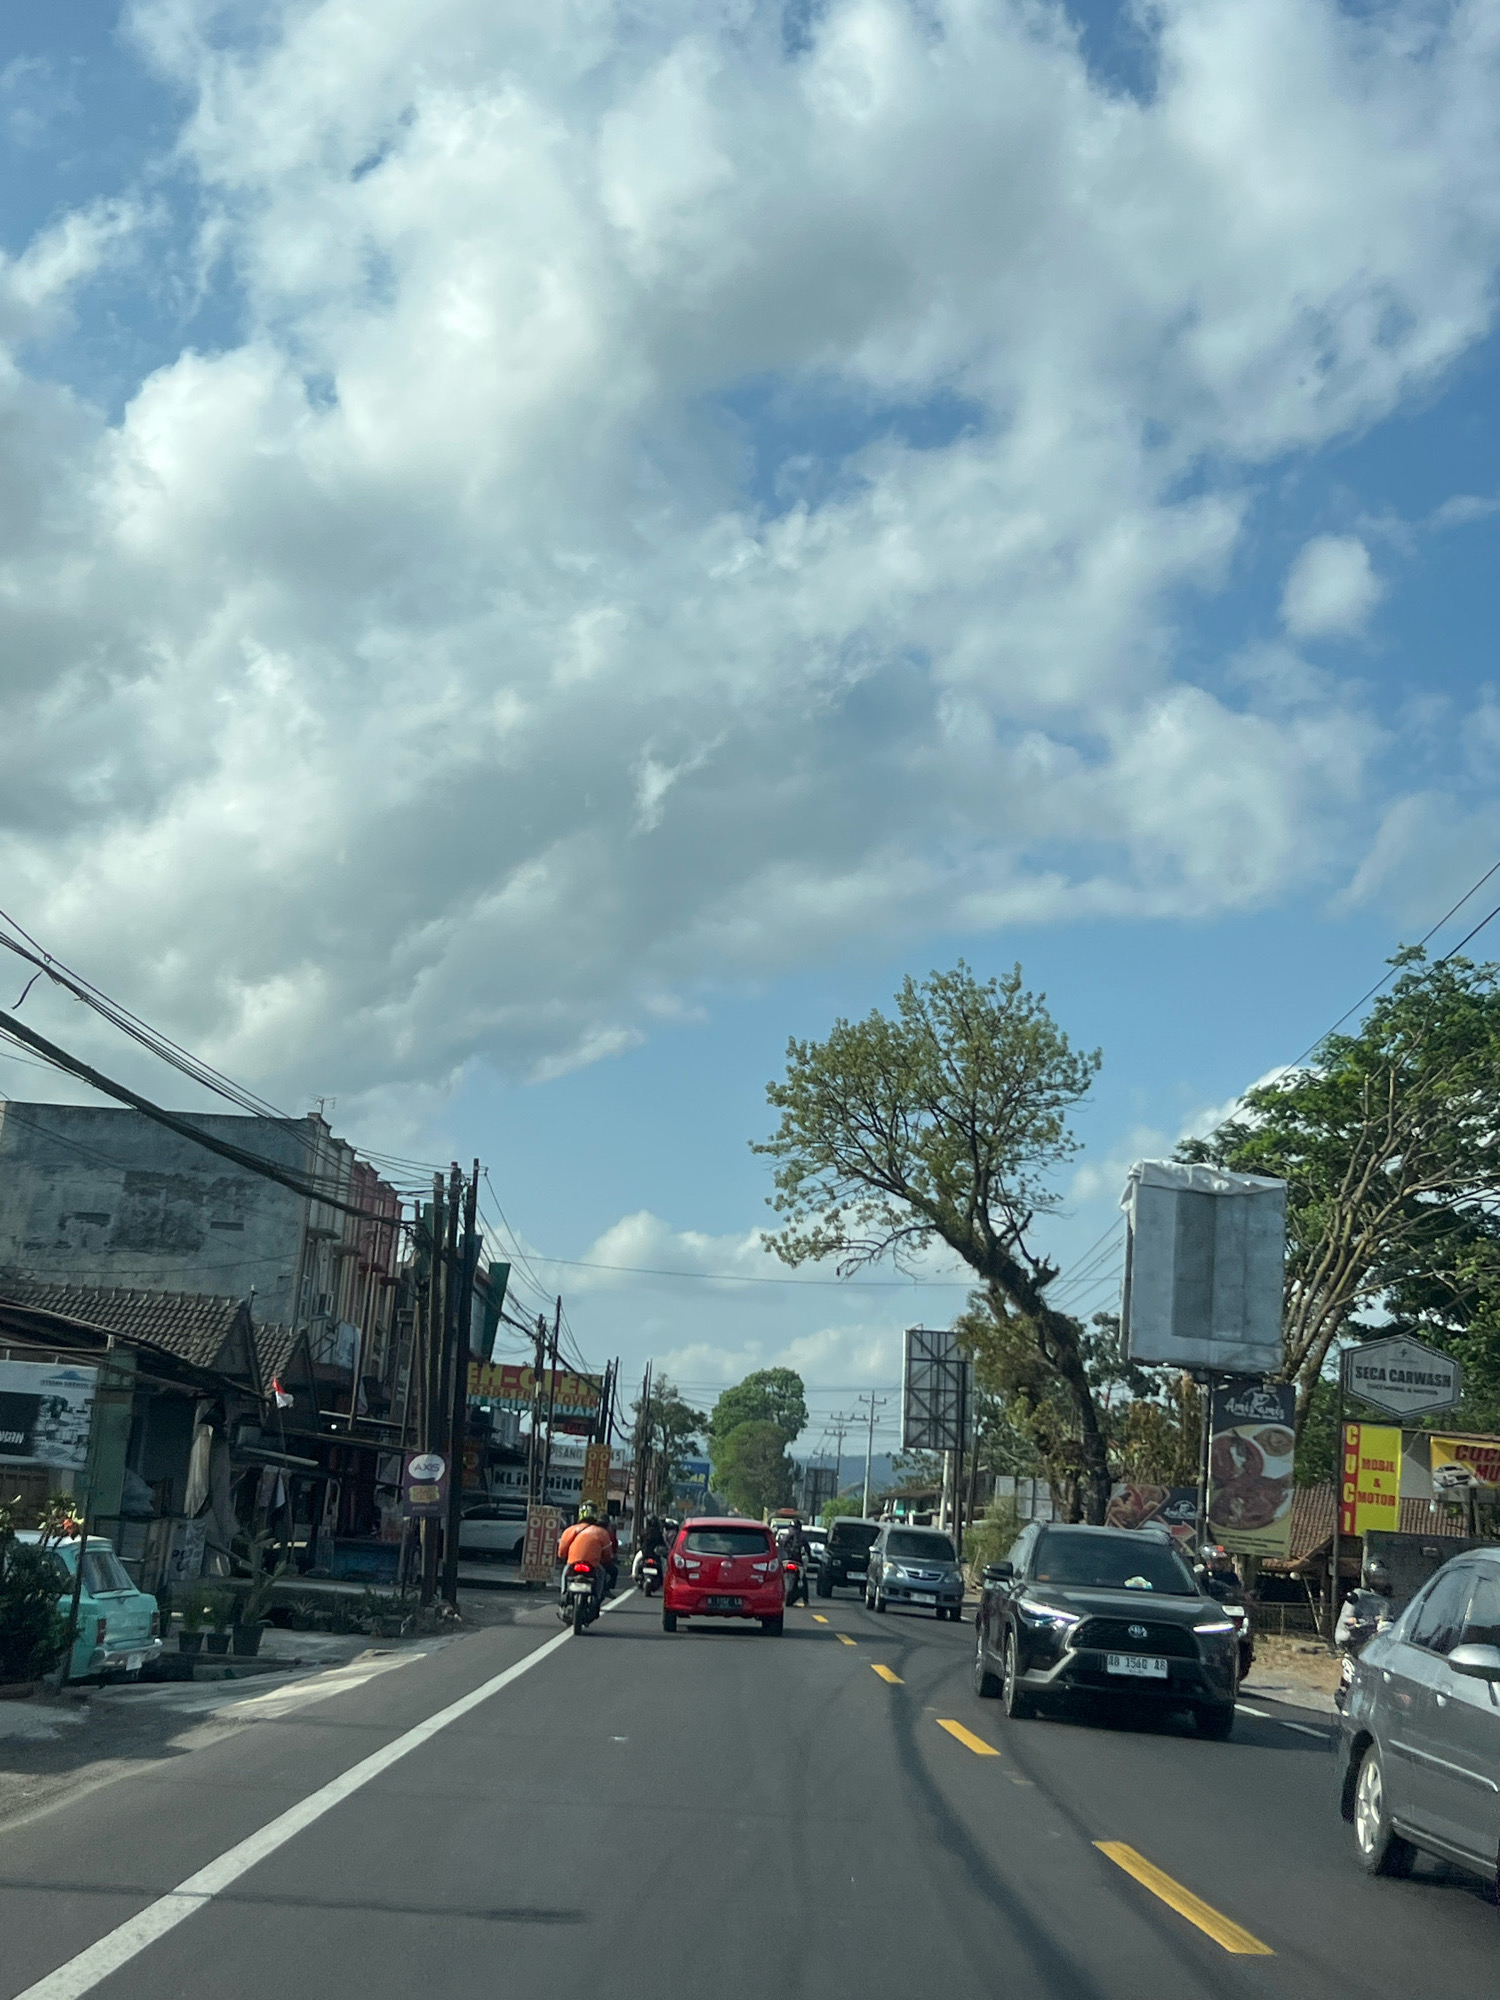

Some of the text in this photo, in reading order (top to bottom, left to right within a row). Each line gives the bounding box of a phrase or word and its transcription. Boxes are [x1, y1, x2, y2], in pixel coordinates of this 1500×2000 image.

[1355, 1366, 1451, 1388] SECA CARWASH
[562, 1393, 598, 1408] OVEN
[552, 1403, 597, 1418] BUAH
[1361, 1458, 1396, 1473] MOBIL
[1343, 1425, 1359, 1532] CUCI
[1373, 1478, 1381, 1488] &
[1357, 1490, 1396, 1507] MOTOR
[525, 1517, 541, 1565] OLEH
[541, 1518, 557, 1567] OLEH
